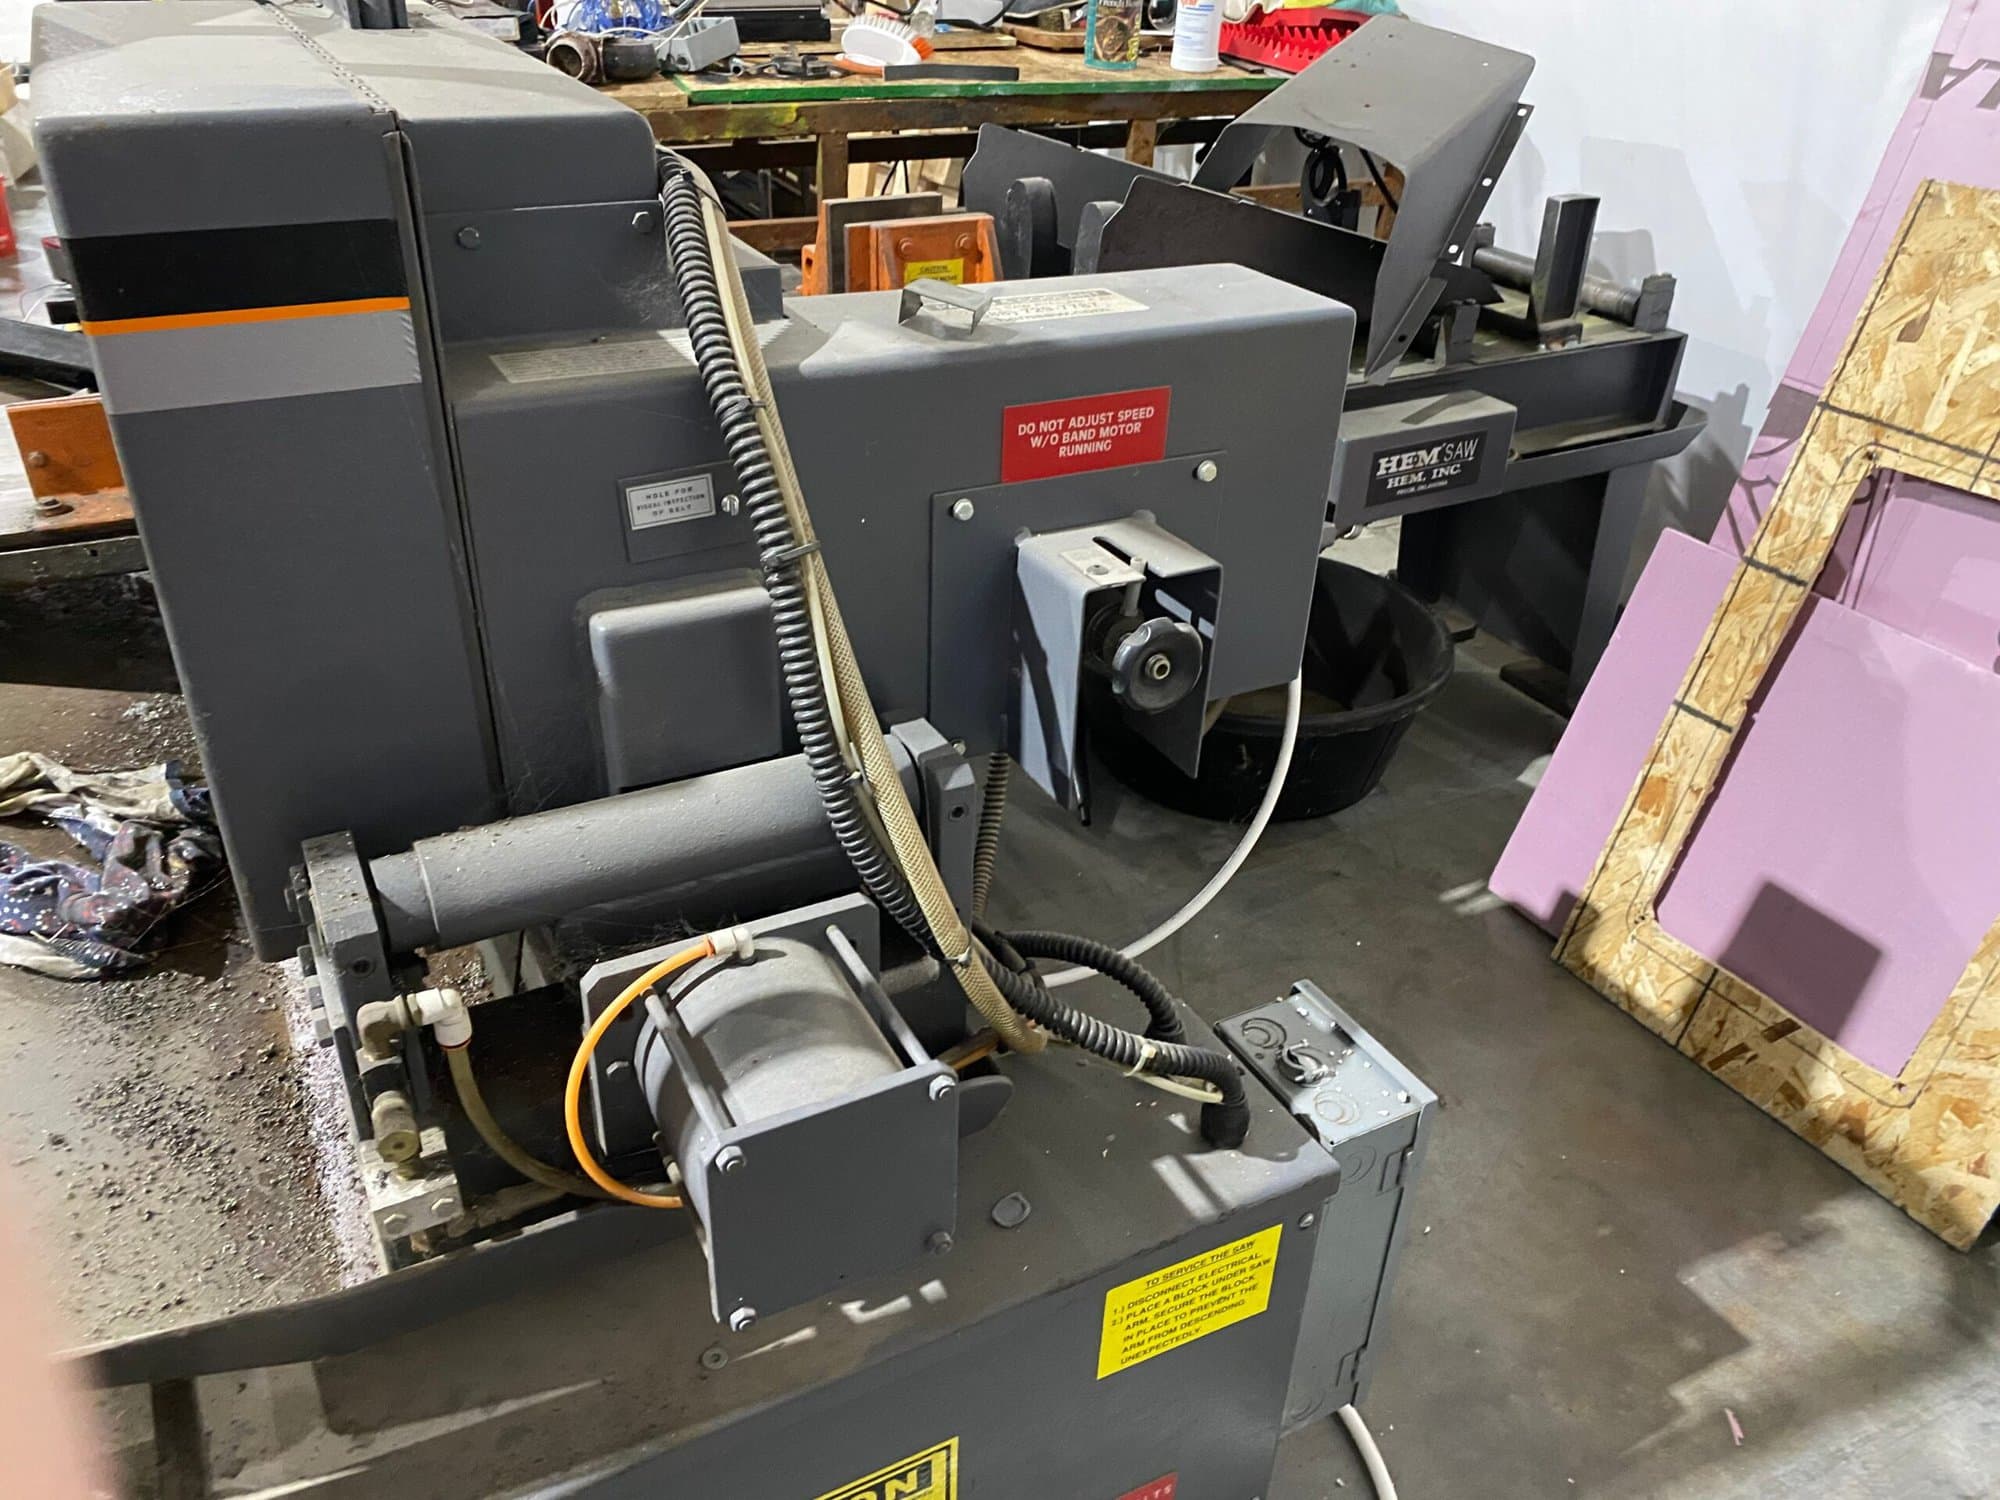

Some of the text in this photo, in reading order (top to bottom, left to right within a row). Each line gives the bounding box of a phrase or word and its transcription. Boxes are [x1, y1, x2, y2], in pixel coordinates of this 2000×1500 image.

[1018, 406, 1154, 436] DO NOT ADJUST SPEED
[1030, 422, 1142, 449] W/O BAND MOTOR
[1059, 440, 1112, 458] RUNNING
[1443, 438, 1479, 462] SAW
[646, 486, 693, 500] HOLE FOR
[1145, 1239, 1256, 1288] TO SERVICE THE SAW
[1126, 1301, 1163, 1321] PLACE
[1163, 1297, 1171, 1306] A
[1173, 1283, 1209, 1301] BLOCK
[1212, 1267, 1247, 1286] UNDER
[1249, 1257, 1273, 1271] SAW
[1127, 1277, 1196, 1310] DISCONNECT
[1154, 1298, 1196, 1322] SECURE
[1199, 1288, 1218, 1302] THE
[1221, 1275, 1256, 1292] BLOCK
[1123, 1282, 1259, 1343] IN PLACE TO PREVENT THE
[1121, 1340, 1145, 1354] ARM
[1147, 1326, 1177, 1343] FROM
